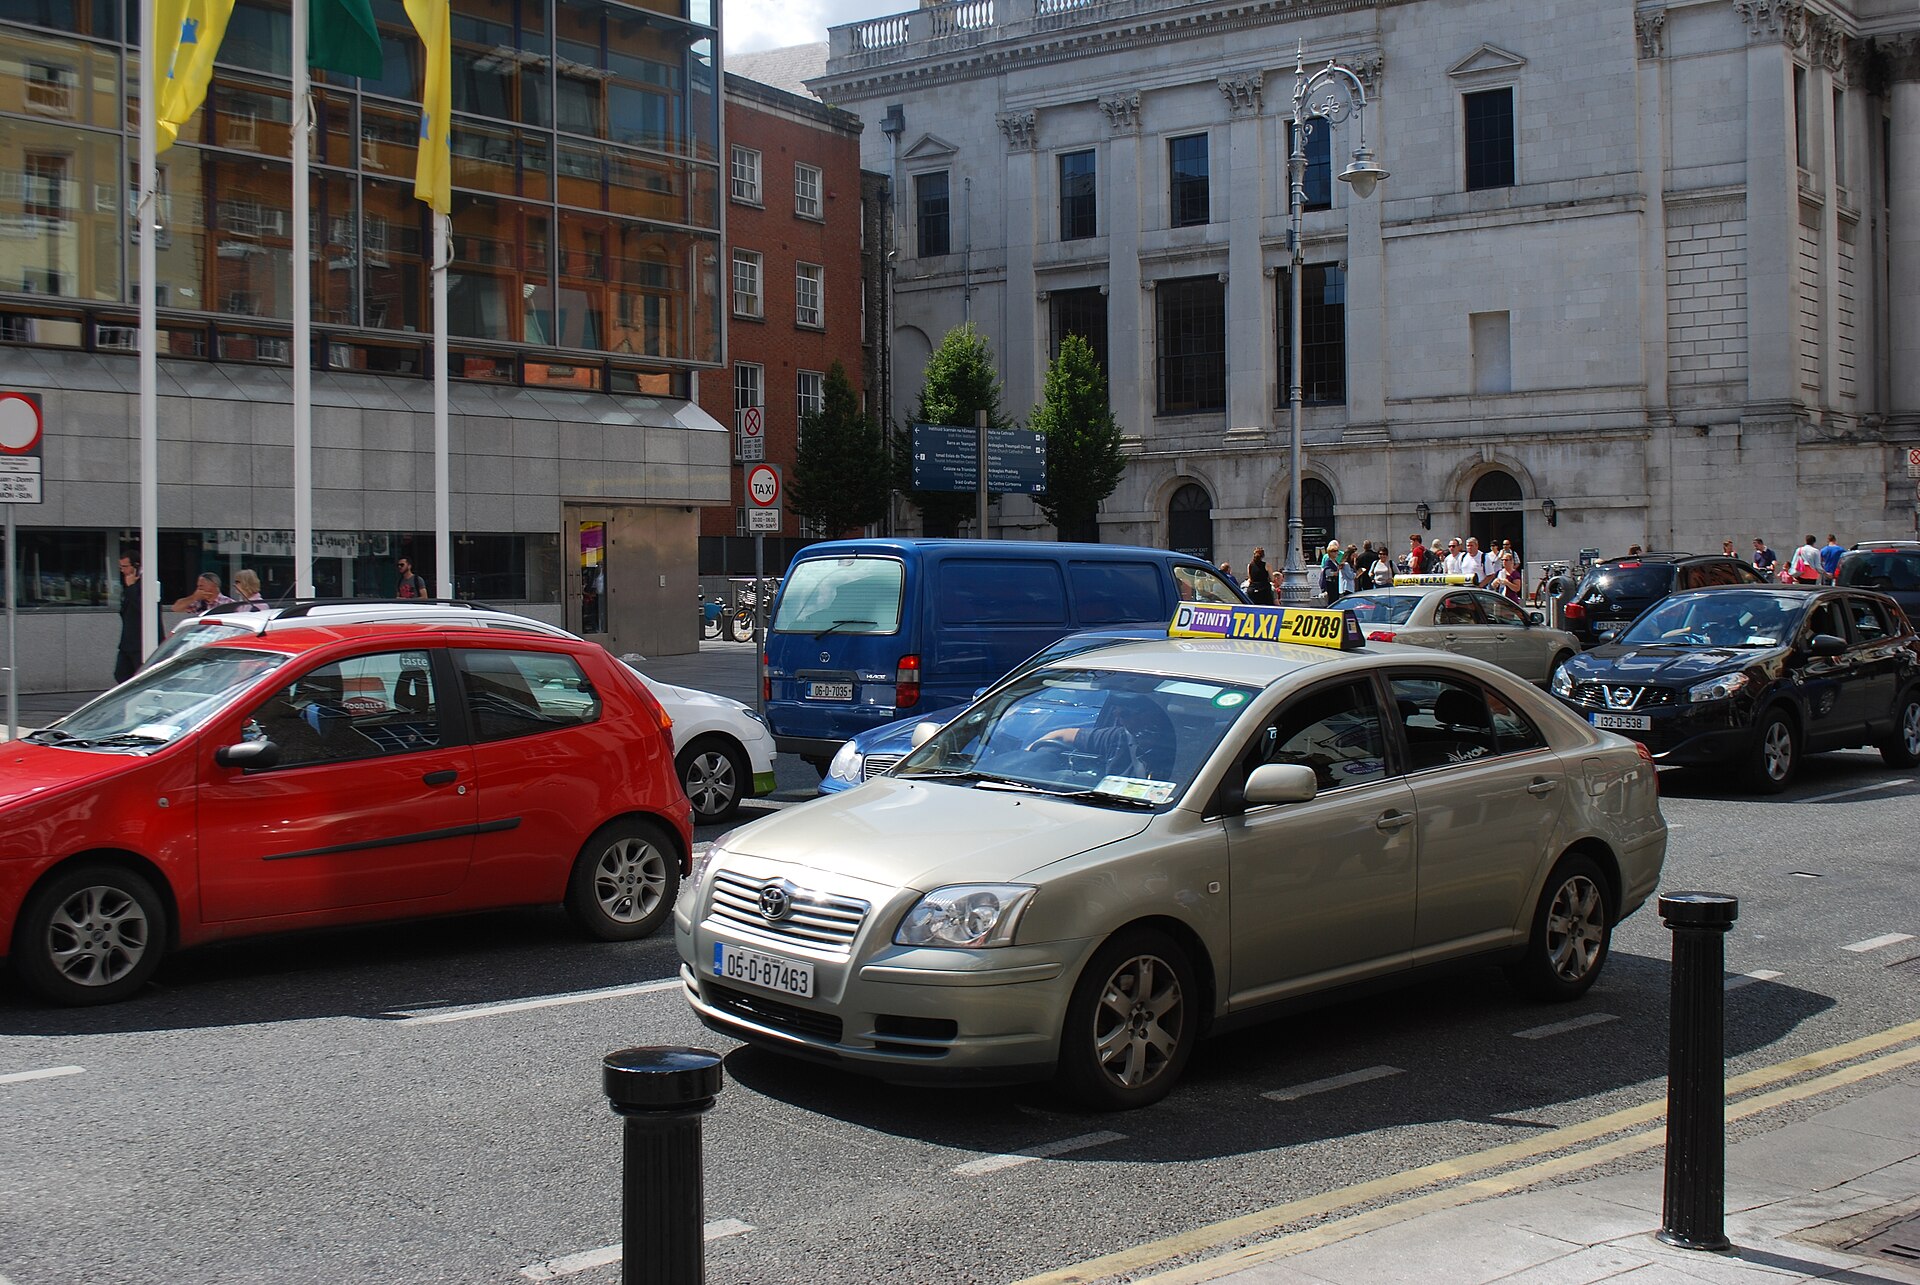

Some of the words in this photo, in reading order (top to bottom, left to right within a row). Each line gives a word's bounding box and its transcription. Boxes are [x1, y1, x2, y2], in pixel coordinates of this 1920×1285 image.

[754, 484, 773, 494] TAXI
[1192, 607, 1231, 628] TRINITY
[1233, 613, 1278, 638] TAXI
[1292, 614, 1341, 639] 20789
[402, 658, 428, 666] taste
[1601, 717, 1641, 728] 132-D-538
[728, 954, 808, 993] 05-D-87463
